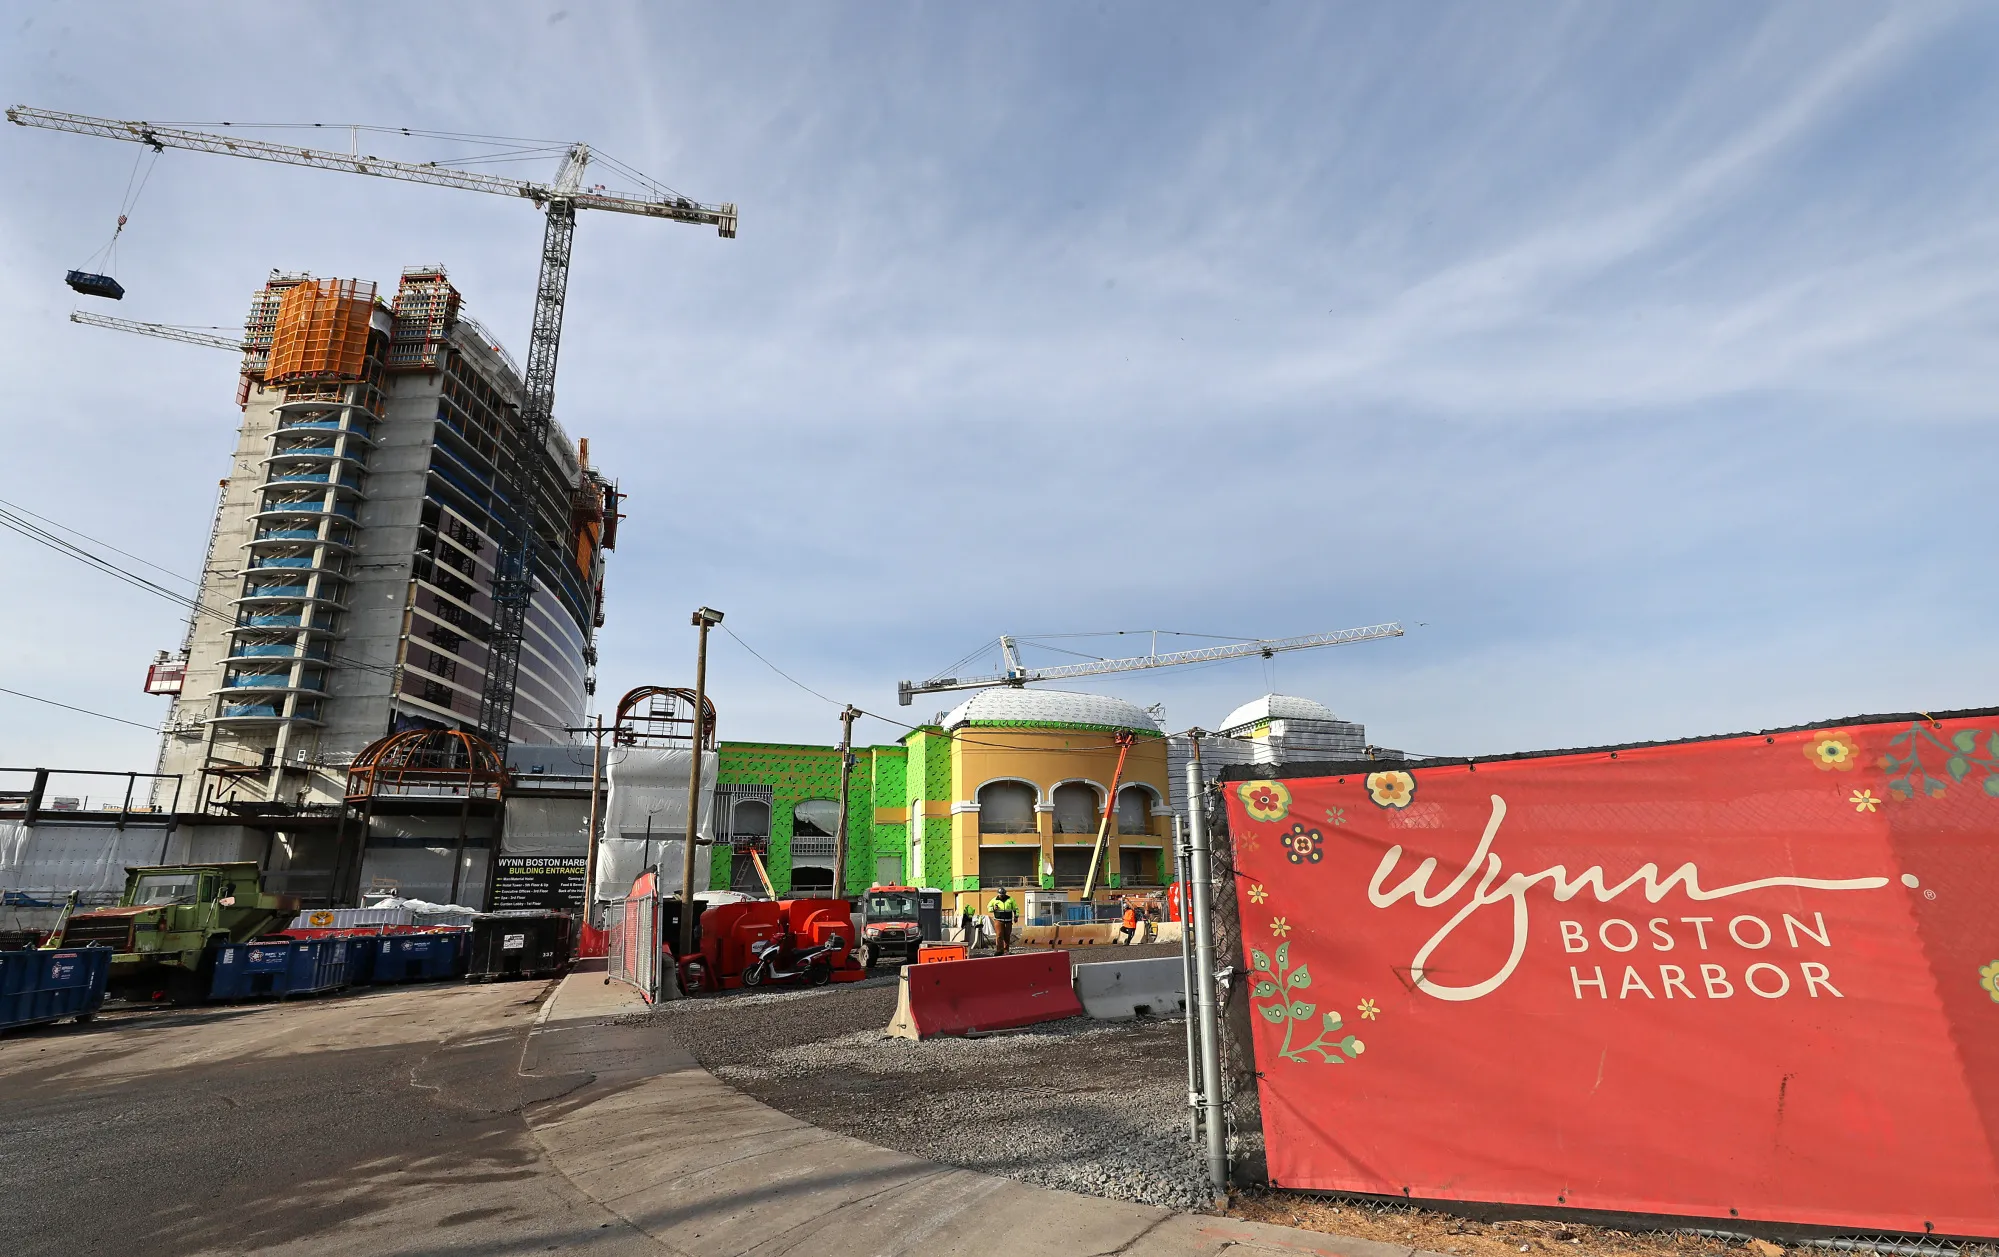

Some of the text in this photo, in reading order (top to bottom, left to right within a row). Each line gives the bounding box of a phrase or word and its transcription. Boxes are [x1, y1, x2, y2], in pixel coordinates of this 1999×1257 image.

[498, 858, 524, 867] WYNN
[526, 858, 560, 867] BOSTON
[509, 867, 585, 875] BUILDING ENTRANCE
[1559, 911, 1832, 953] BOSTON
[1569, 961, 1845, 1000] HARBOR
